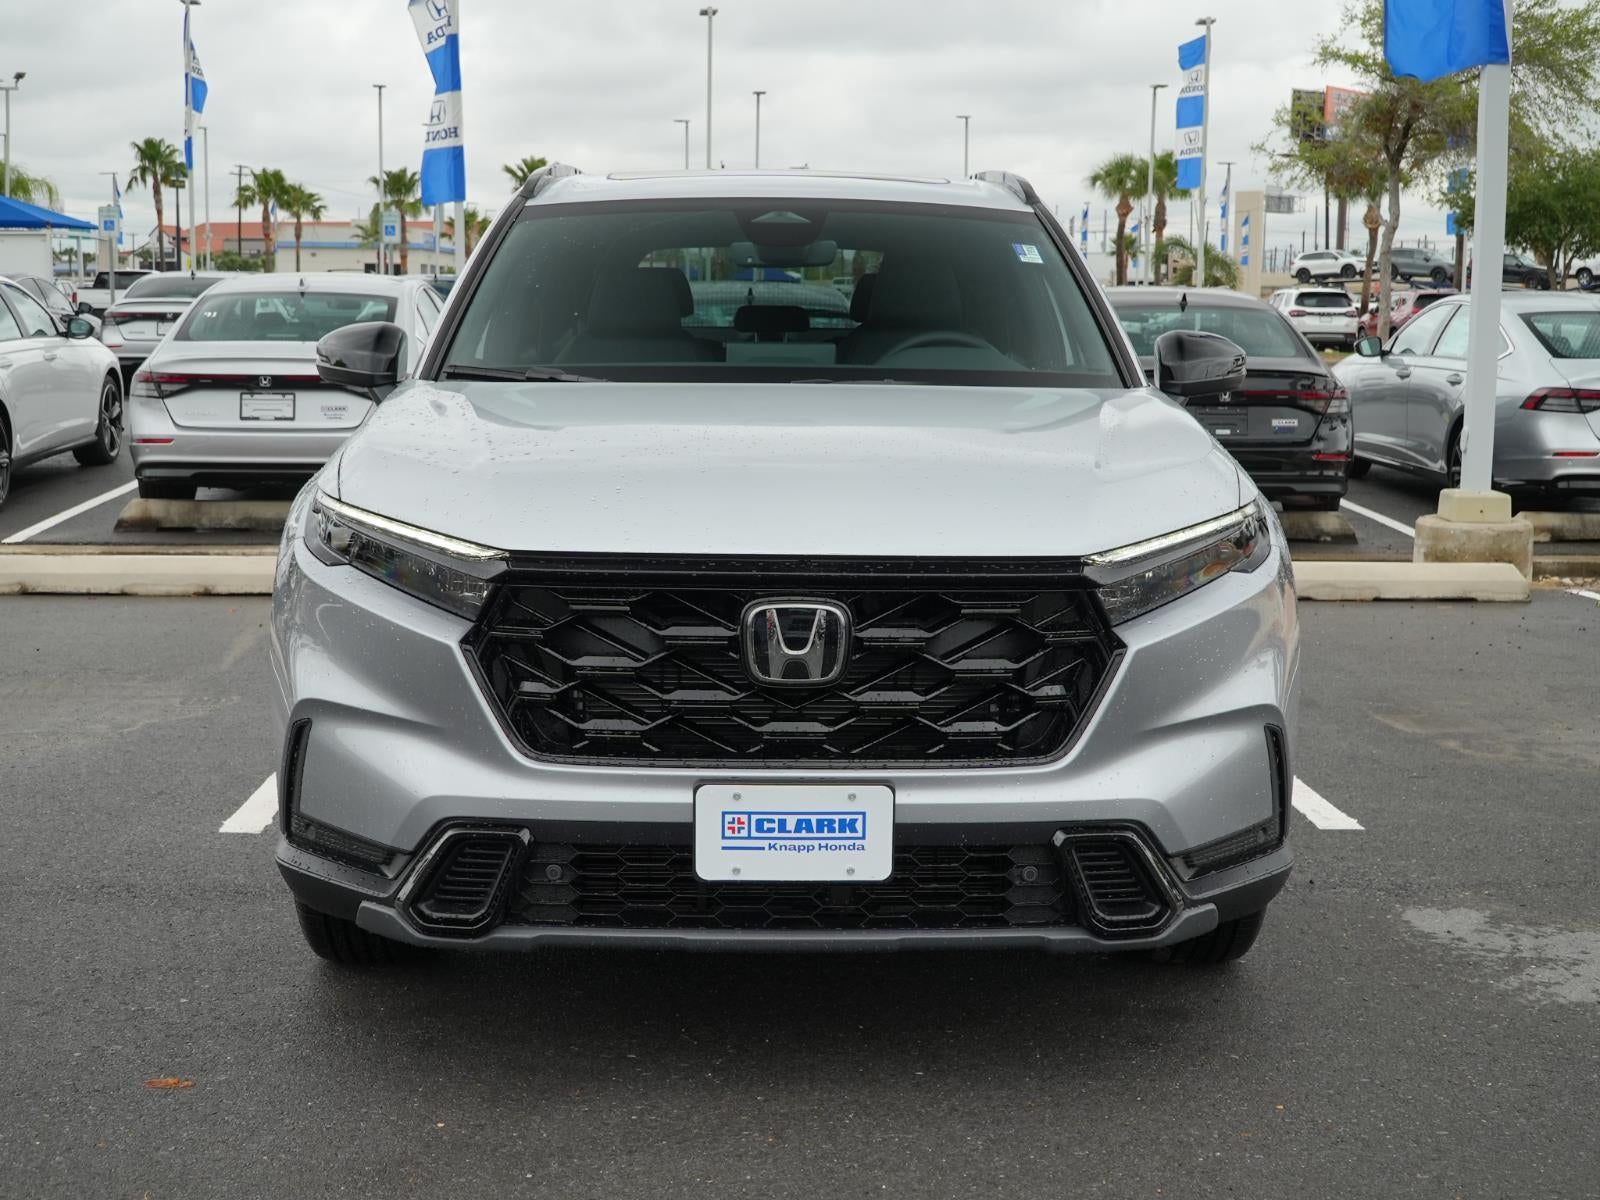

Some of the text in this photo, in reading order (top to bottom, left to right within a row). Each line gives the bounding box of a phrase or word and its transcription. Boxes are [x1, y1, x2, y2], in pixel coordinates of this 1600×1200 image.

[754, 818, 860, 834] CLARK
[768, 842, 866, 854] Knapp Honda
